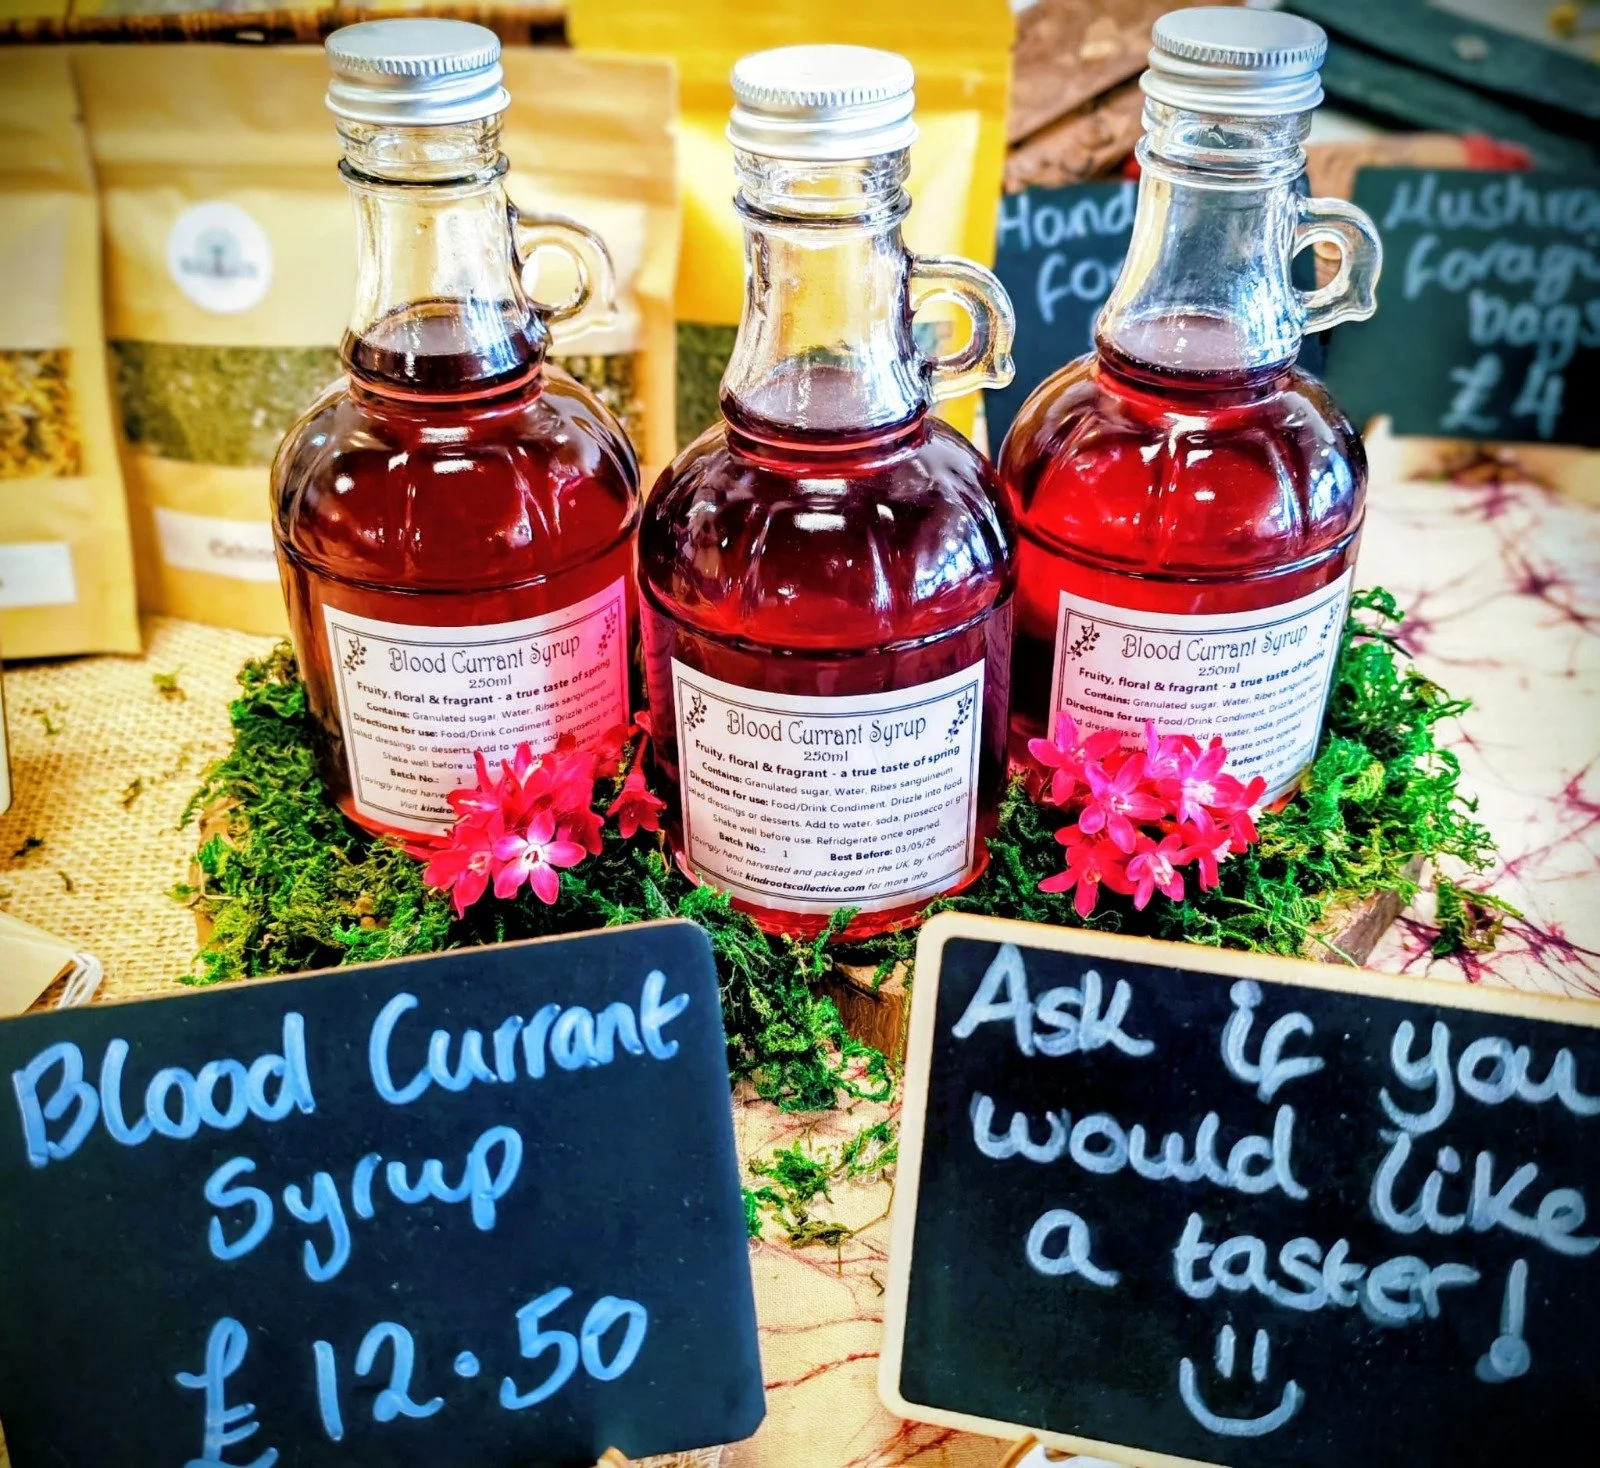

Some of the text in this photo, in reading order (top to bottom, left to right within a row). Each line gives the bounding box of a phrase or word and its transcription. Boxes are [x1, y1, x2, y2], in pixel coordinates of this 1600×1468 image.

[388, 636, 580, 673] Blood Currant Syrup
[1121, 625, 1308, 662] Blood Currant Syrup
[357, 681, 391, 699] Fruity,
[394, 691, 424, 704] floral
[429, 695, 440, 704] &
[443, 695, 493, 707] fragrant
[516, 688, 540, 699] true
[543, 680, 569, 693] taste
[572, 671, 585, 683] of
[584, 659, 611, 679] spring
[469, 674, 512, 689] 250ml
[1079, 667, 1115, 686] Fruity,
[1118, 676, 1150, 690] floral
[1154, 682, 1165, 692] &
[1168, 683, 1218, 695] fragrant
[1240, 678, 1263, 688] true
[1266, 669, 1289, 682] taste
[1291, 660, 1301, 673] of
[1198, 662, 1240, 677] 250ml
[366, 702, 410, 719] Contains:
[412, 711, 466, 722] Granulated
[535, 700, 559, 712] Ribes
[1065, 697, 1115, 719] Directions
[1117, 711, 1132, 722] for
[1158, 716, 1213, 726] Food/Drink
[1084, 688, 1130, 706] Contains:
[1133, 698, 1187, 710] Granulated
[1254, 690, 1277, 702] Ribes
[353, 712, 399, 732] Directions
[401, 725, 415, 735] for
[419, 730, 438, 738] use:
[441, 730, 496, 739] Food/Drink
[555, 708, 583, 723] Drizzle
[584, 700, 598, 712] into
[727, 709, 926, 747] Blood Currant Syrup
[375, 736, 415, 752] dressings
[476, 745, 497, 753] Add
[382, 751, 409, 764] Shake
[411, 757, 429, 767] well
[432, 762, 463, 770] before
[695, 739, 726, 761] Fruity,
[729, 754, 759, 770] floral
[762, 762, 774, 773] &
[776, 765, 828, 779] fragrant
[840, 770, 848, 778] a
[852, 768, 877, 778] true
[881, 762, 910, 774] taste
[913, 756, 926, 768] of
[928, 745, 961, 764] spring
[803, 750, 848, 762] 250ml
[1231, 754, 1264, 767] Before:
[390, 768, 416, 780] Batch
[702, 762, 743, 784] Contains:
[745, 777, 798, 794] Granulated
[870, 782, 898, 793] Ribes
[900, 766, 953, 788] sanguineum
[395, 786, 418, 796] hand
[400, 800, 419, 810] Visit
[690, 769, 731, 796] Directions
[733, 789, 747, 801] for
[749, 795, 769, 806] use:
[771, 799, 827, 812] Food/Drink
[891, 793, 922, 806] Drizzle
[924, 787, 942, 799] into
[708, 796, 746, 818] dressings
[748, 811, 758, 819] or
[805, 820, 826, 829] Add
[829, 821, 840, 829] to
[904, 804, 943, 821] prosecco
[945, 799, 954, 807] or
[713, 814, 738, 830] Shake
[740, 827, 757, 836] well
[760, 830, 791, 843] before
[816, 835, 878, 847] Refridgerate
[880, 831, 904, 841] once
[719, 832, 744, 848] Batch
[782, 850, 788, 858] 1
[830, 852, 853, 861] Best
[855, 849, 893, 860] Before:
[895, 836, 937, 854] 03/05/26
[723, 849, 744, 862] hand
[746, 858, 792, 874] harvested
[793, 867, 812, 877] and
[813, 868, 863, 879] packaged
[865, 867, 875, 875] in
[877, 864, 893, 874] the
[913, 857, 925, 867] by
[725, 866, 928, 893] Visit kindrootscollective.com for more info
[953, 943, 1600, 1134] Ask if you
[12, 969, 690, 1168] Blood Currant
[971, 1091, 1600, 1256] would like
[202, 1124, 524, 1282] Syrup
[1026, 1208, 1119, 1287] a
